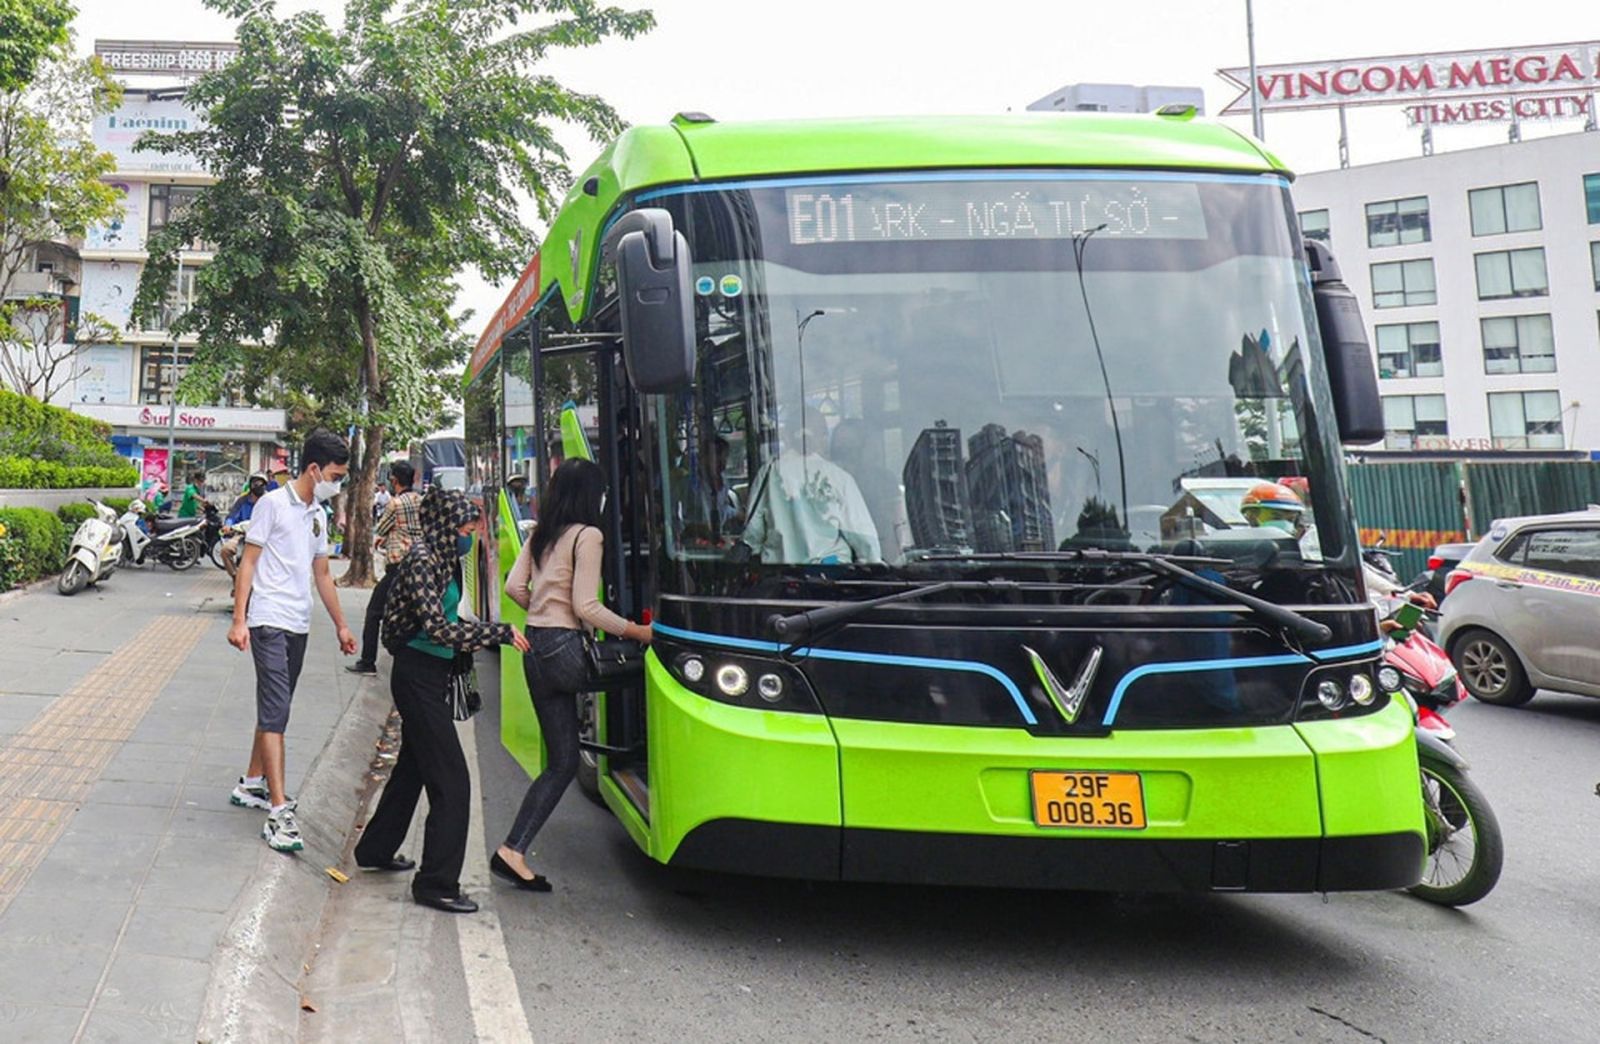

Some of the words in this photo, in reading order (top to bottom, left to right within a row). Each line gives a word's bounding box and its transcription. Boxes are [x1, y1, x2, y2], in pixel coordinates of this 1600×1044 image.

[102, 52, 176, 69] FREESHIP
[1257, 64, 1435, 101] VINCOM
[1449, 53, 1585, 90] MEGA
[1409, 102, 1505, 124] TIMES
[1514, 94, 1592, 117] CITY
[793, 194, 855, 244] E01
[967, 191, 1038, 236] NGÃ
[1104, 186, 1150, 234] SỞ
[179, 412, 216, 427] Store
[1064, 776, 1109, 798] 29F
[1048, 801, 1133, 825] 008.36
